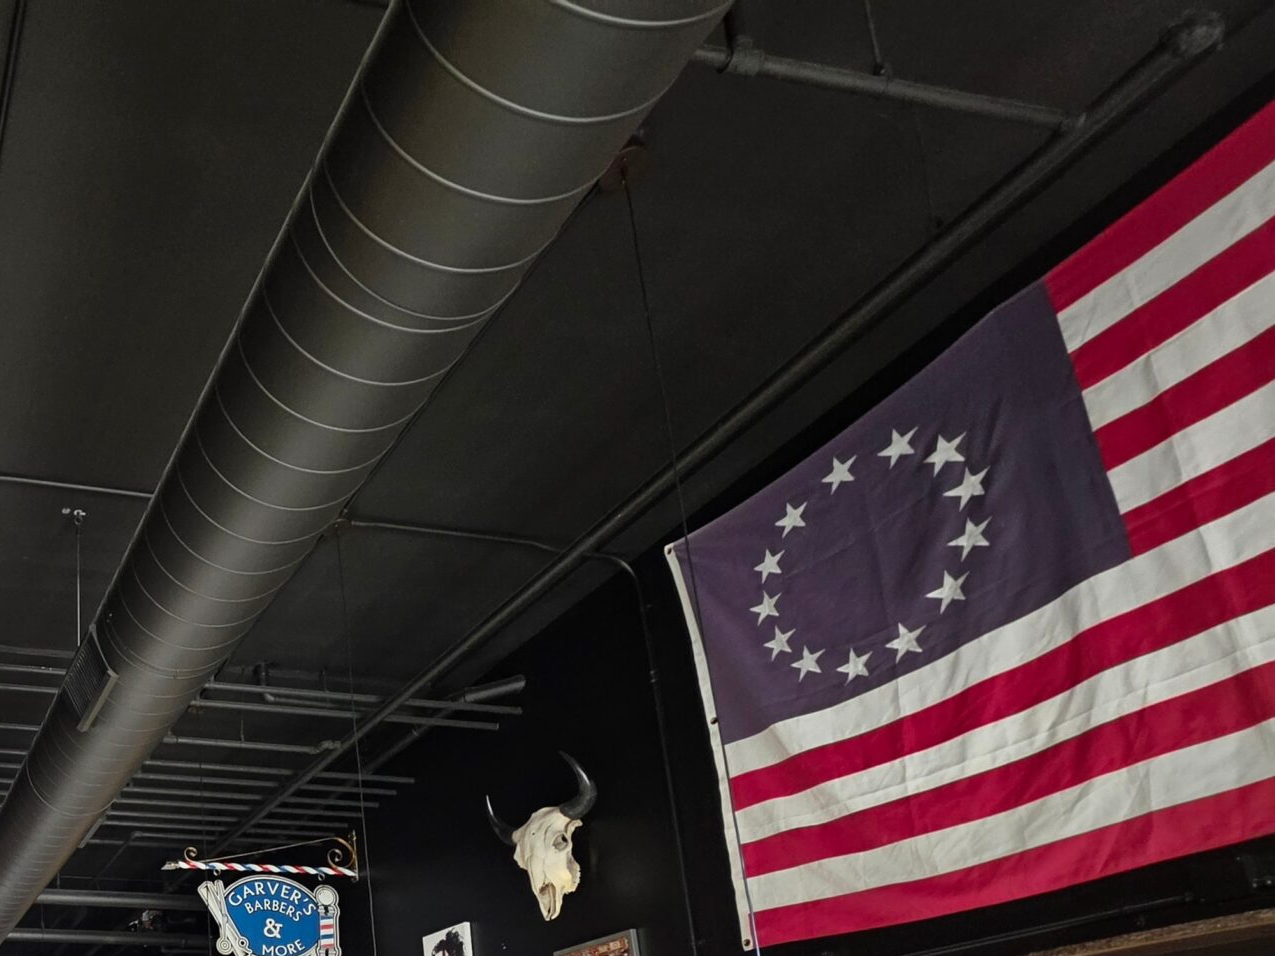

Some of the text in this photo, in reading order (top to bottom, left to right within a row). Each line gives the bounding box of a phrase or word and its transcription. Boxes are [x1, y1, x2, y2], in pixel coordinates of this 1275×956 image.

[228, 881, 317, 916] GARVER'S
[244, 898, 302, 922] BARBERS
[263, 918, 283, 938] &
[261, 939, 306, 956] MORE
